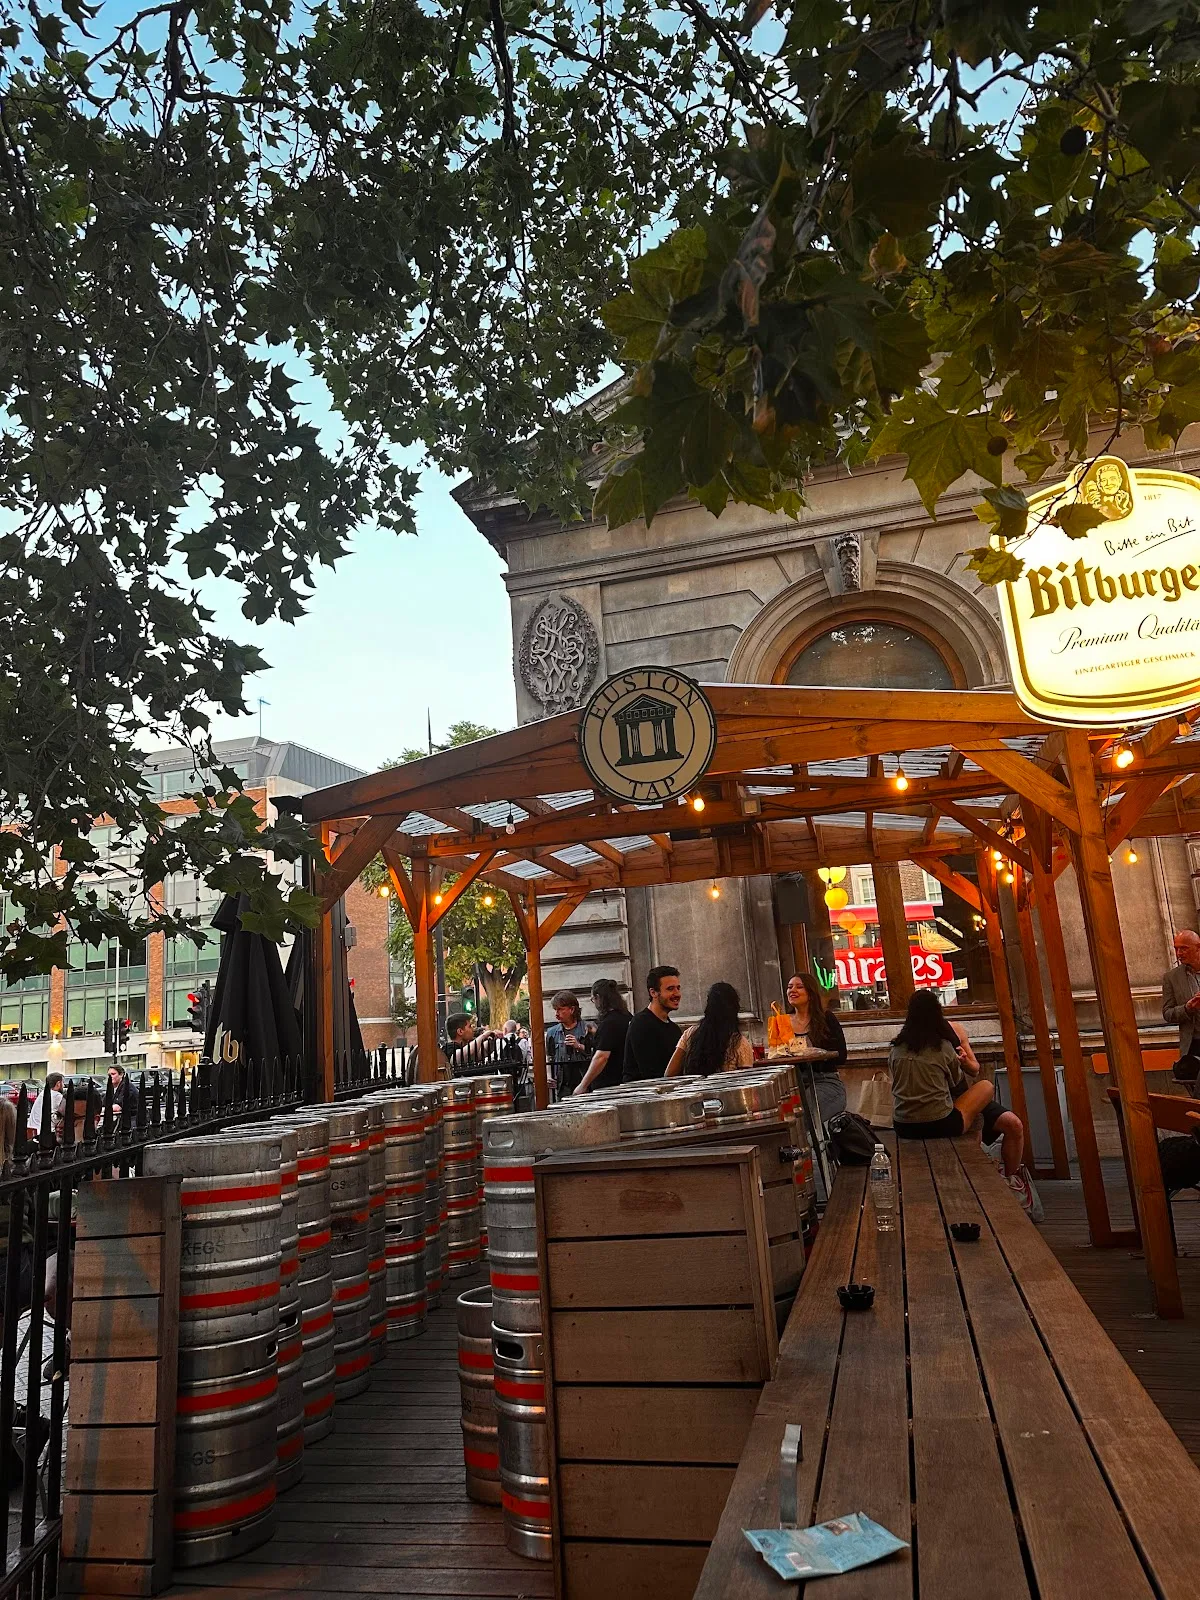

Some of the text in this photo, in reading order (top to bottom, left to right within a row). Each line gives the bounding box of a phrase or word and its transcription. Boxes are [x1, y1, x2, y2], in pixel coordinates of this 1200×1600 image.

[1104, 516, 1194, 556] Bitte ein Bit
[1025, 557, 1200, 619] Bitburge
[1050, 626, 1129, 655] Premium
[1074, 651, 1196, 676] EINZIGARTIGER GESCHMACK
[588, 670, 701, 721] EUSTON
[628, 776, 676, 799] TAP
